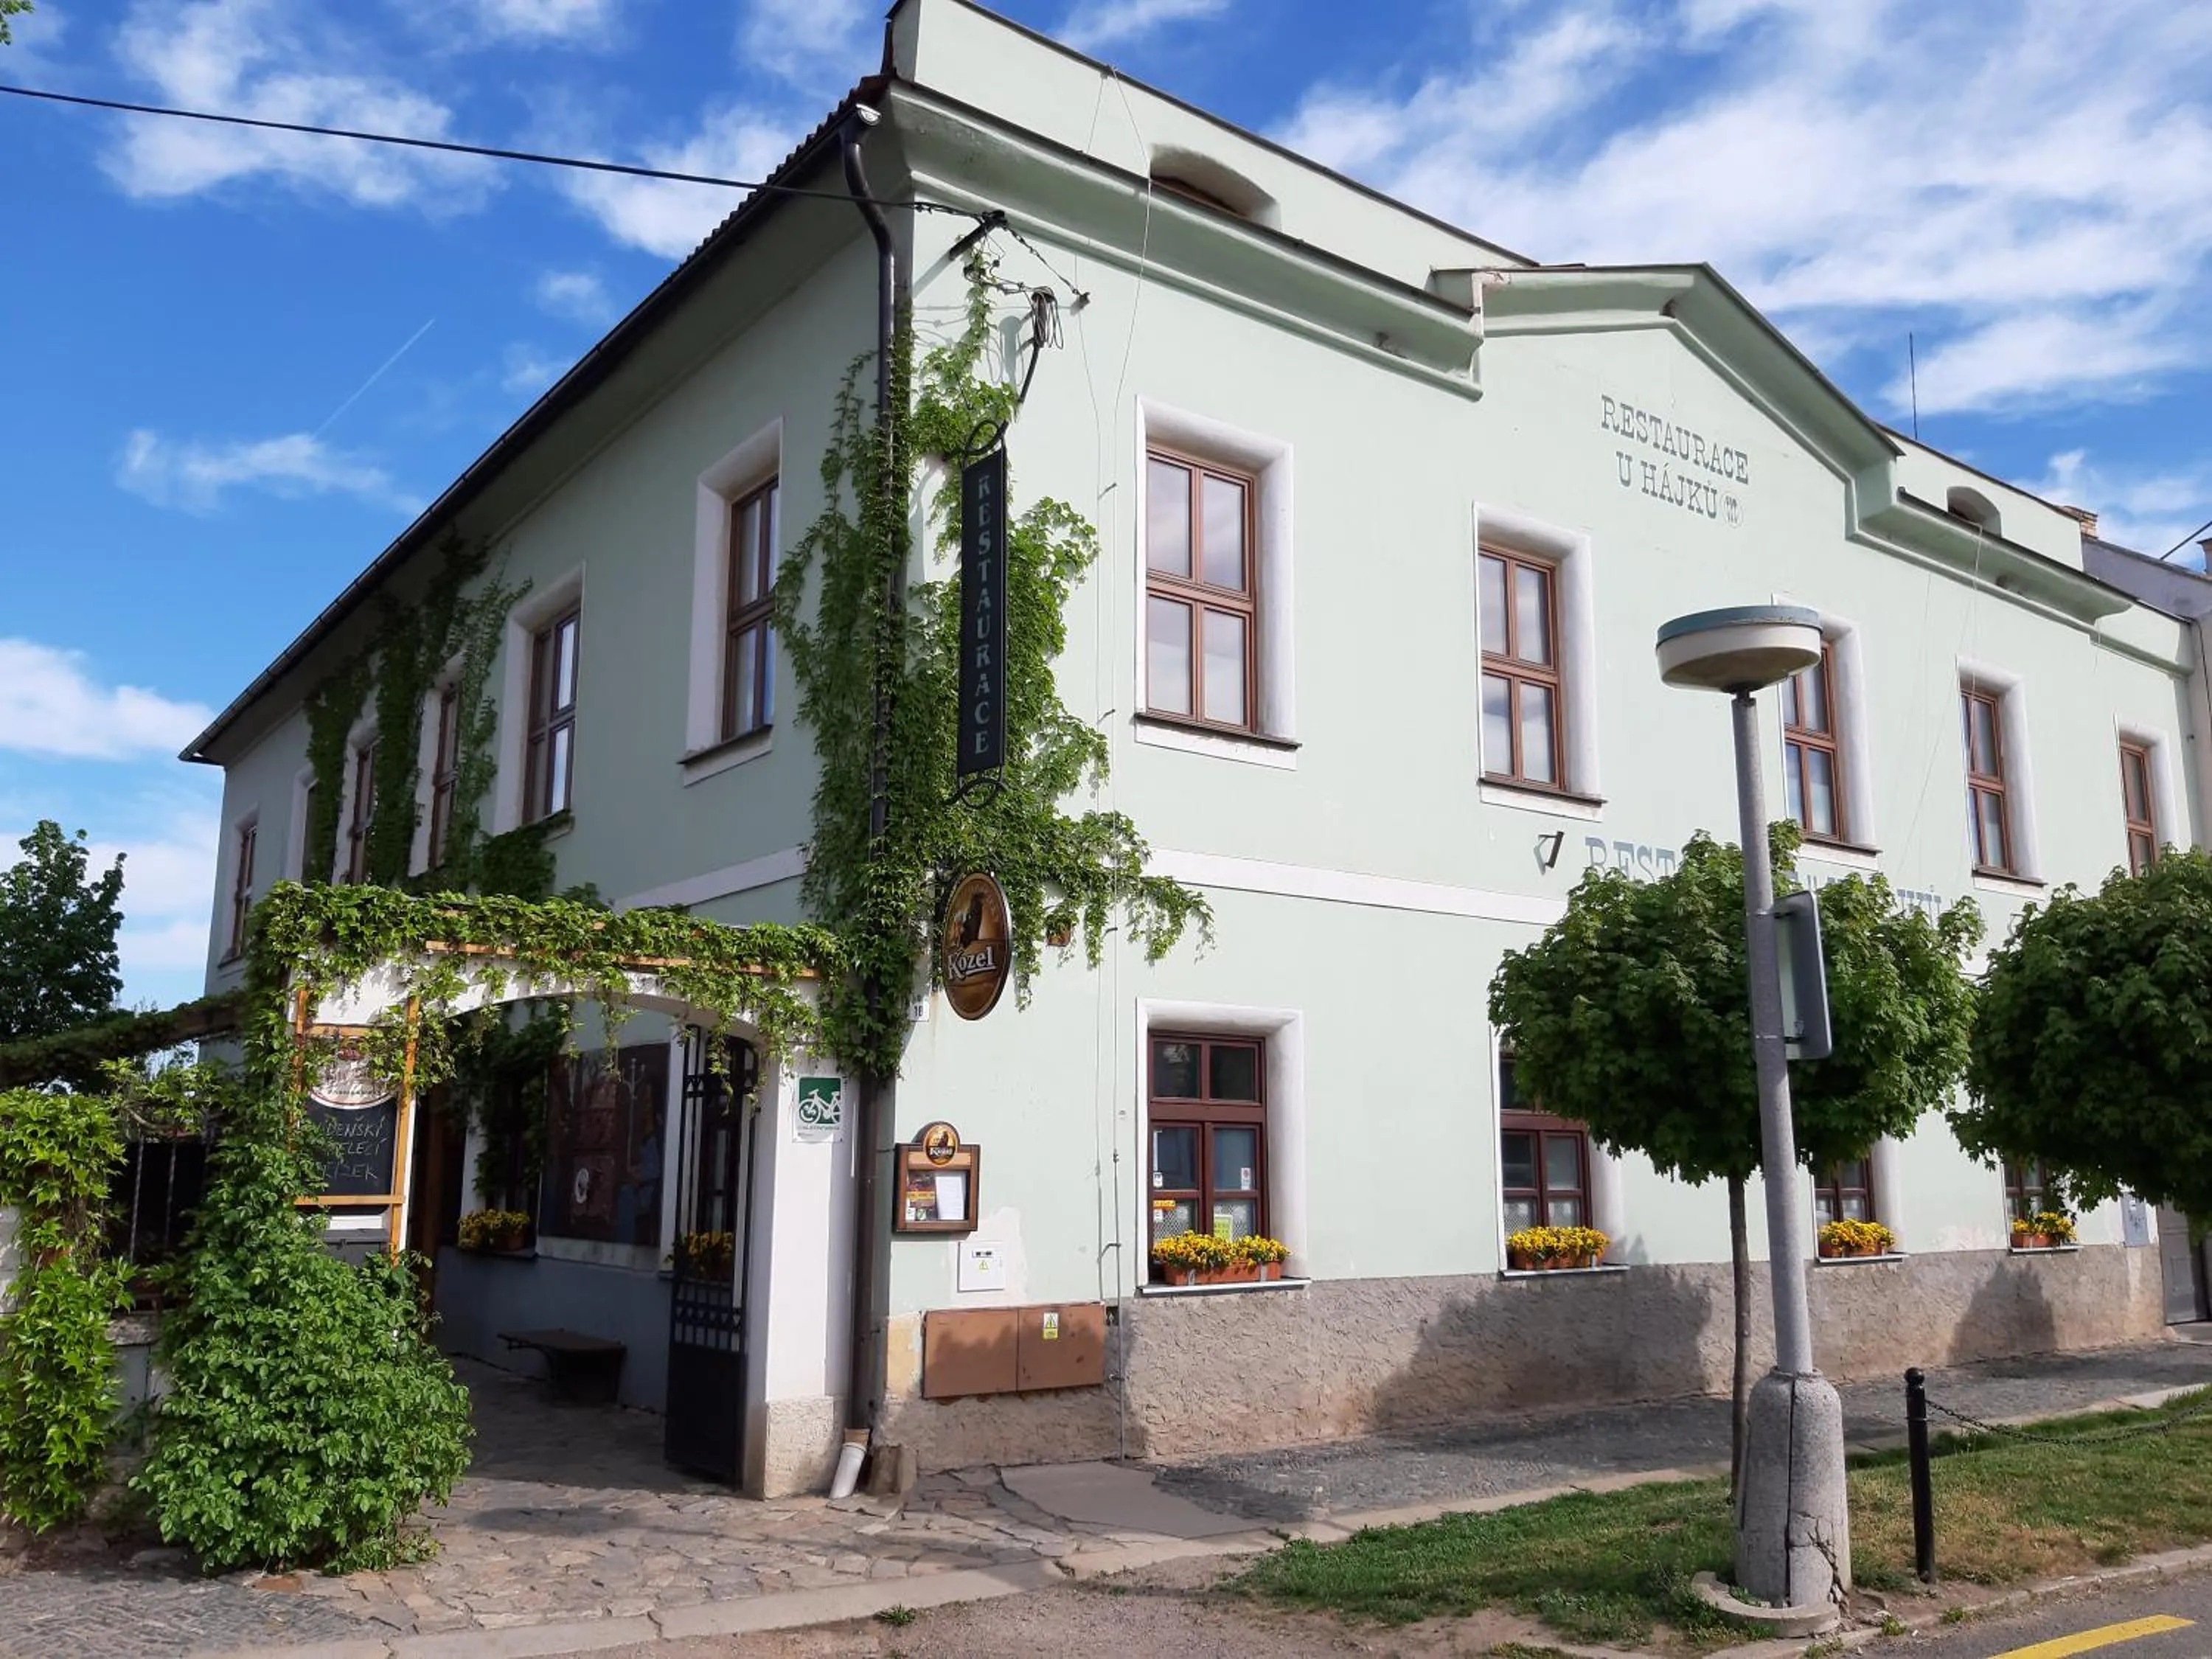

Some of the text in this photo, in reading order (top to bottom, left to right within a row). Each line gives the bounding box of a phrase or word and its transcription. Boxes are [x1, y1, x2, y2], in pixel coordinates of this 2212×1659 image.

[1601, 394, 1749, 484] RESTAURACE
[1615, 451, 1632, 487] U
[1641, 460, 1718, 519] HÁJKŮ
[974, 475, 992, 755] RESTAURACE
[947, 946, 996, 981] Kozel
